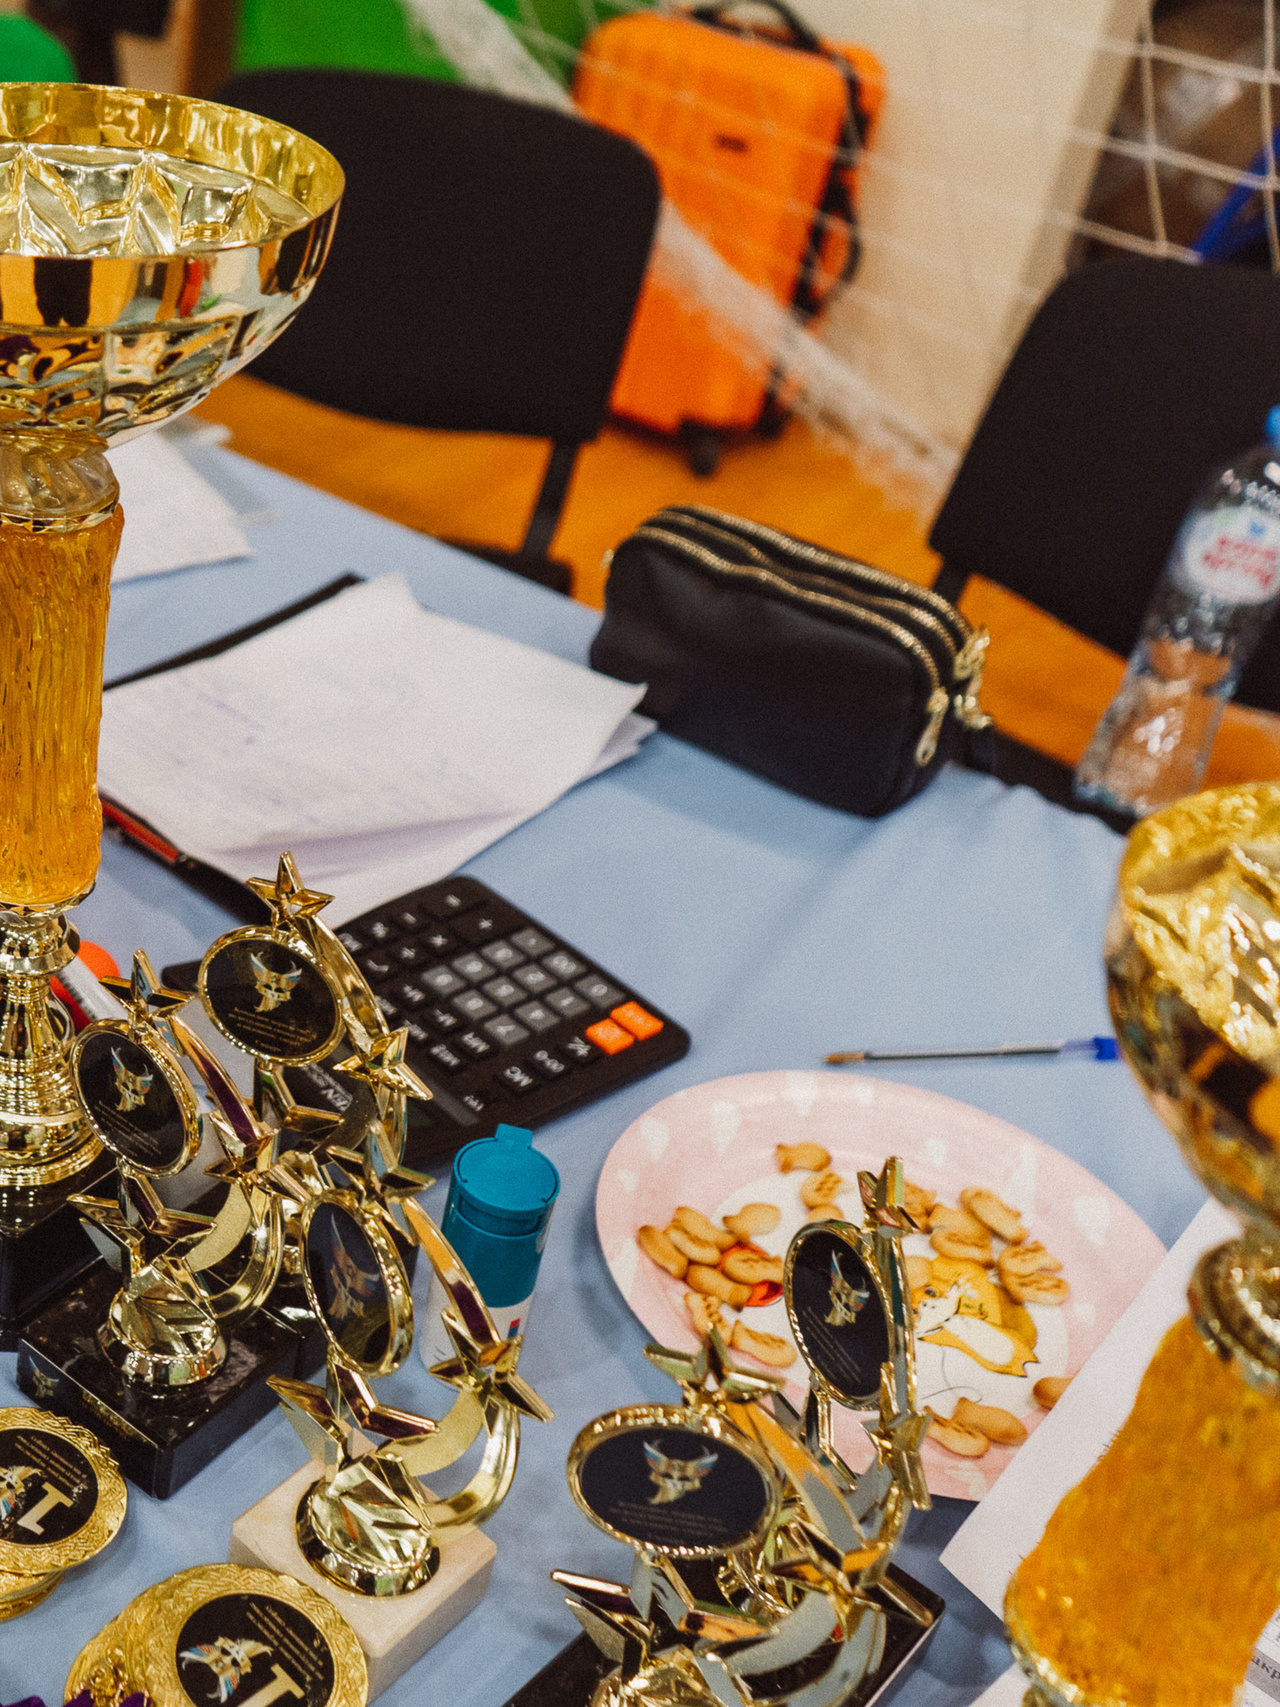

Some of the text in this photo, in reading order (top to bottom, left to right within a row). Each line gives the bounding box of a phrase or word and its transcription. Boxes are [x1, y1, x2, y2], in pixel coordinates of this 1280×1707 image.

[503, 1065, 533, 1087] MC
[16, 1481, 75, 1536] 1
[236, 1663, 306, 1707] 1
